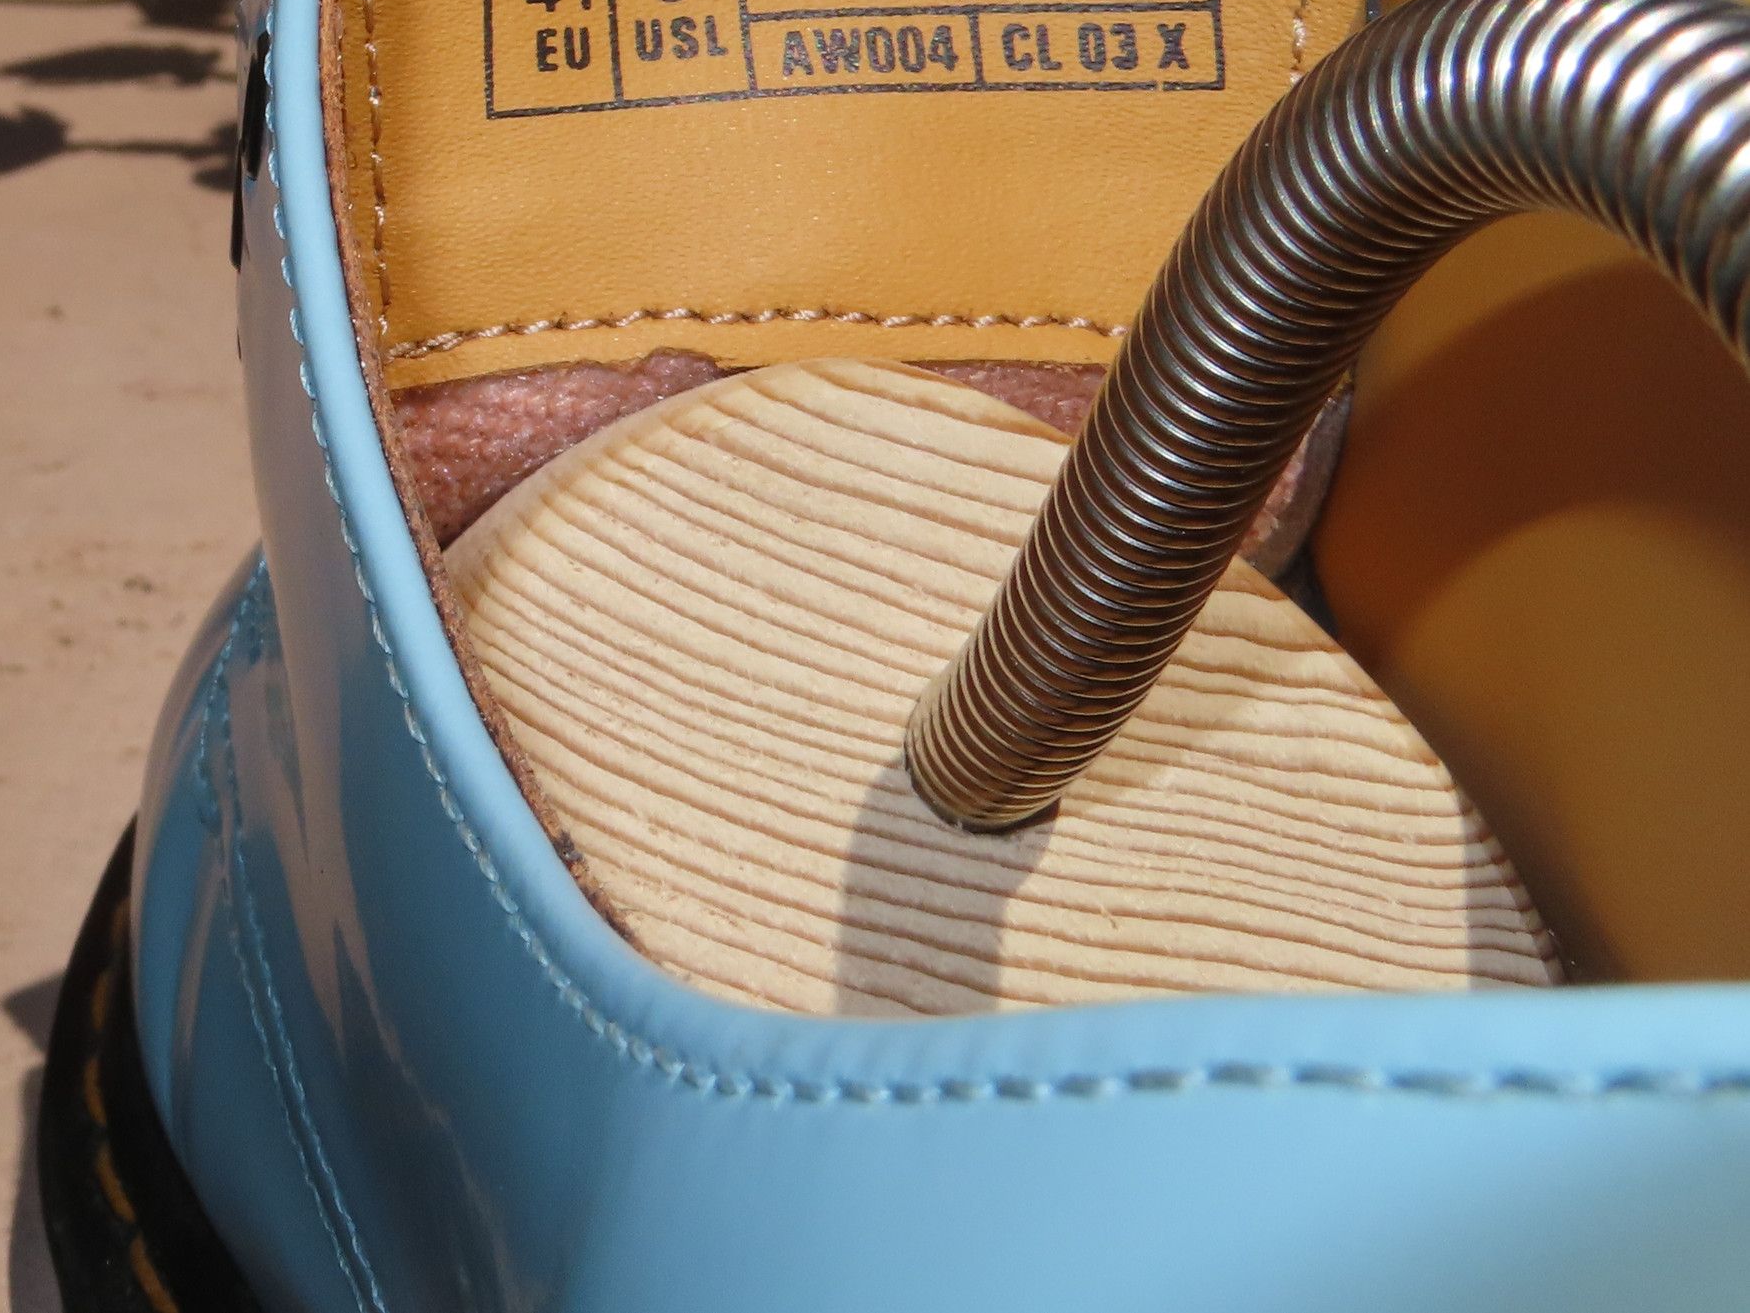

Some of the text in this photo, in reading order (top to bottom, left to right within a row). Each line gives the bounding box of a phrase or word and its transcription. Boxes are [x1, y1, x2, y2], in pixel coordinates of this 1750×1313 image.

[536, 26, 591, 72] EU
[635, 15, 729, 61] USL
[782, 24, 958, 77] AW004
[1001, 23, 1189, 73] CL 03 X
